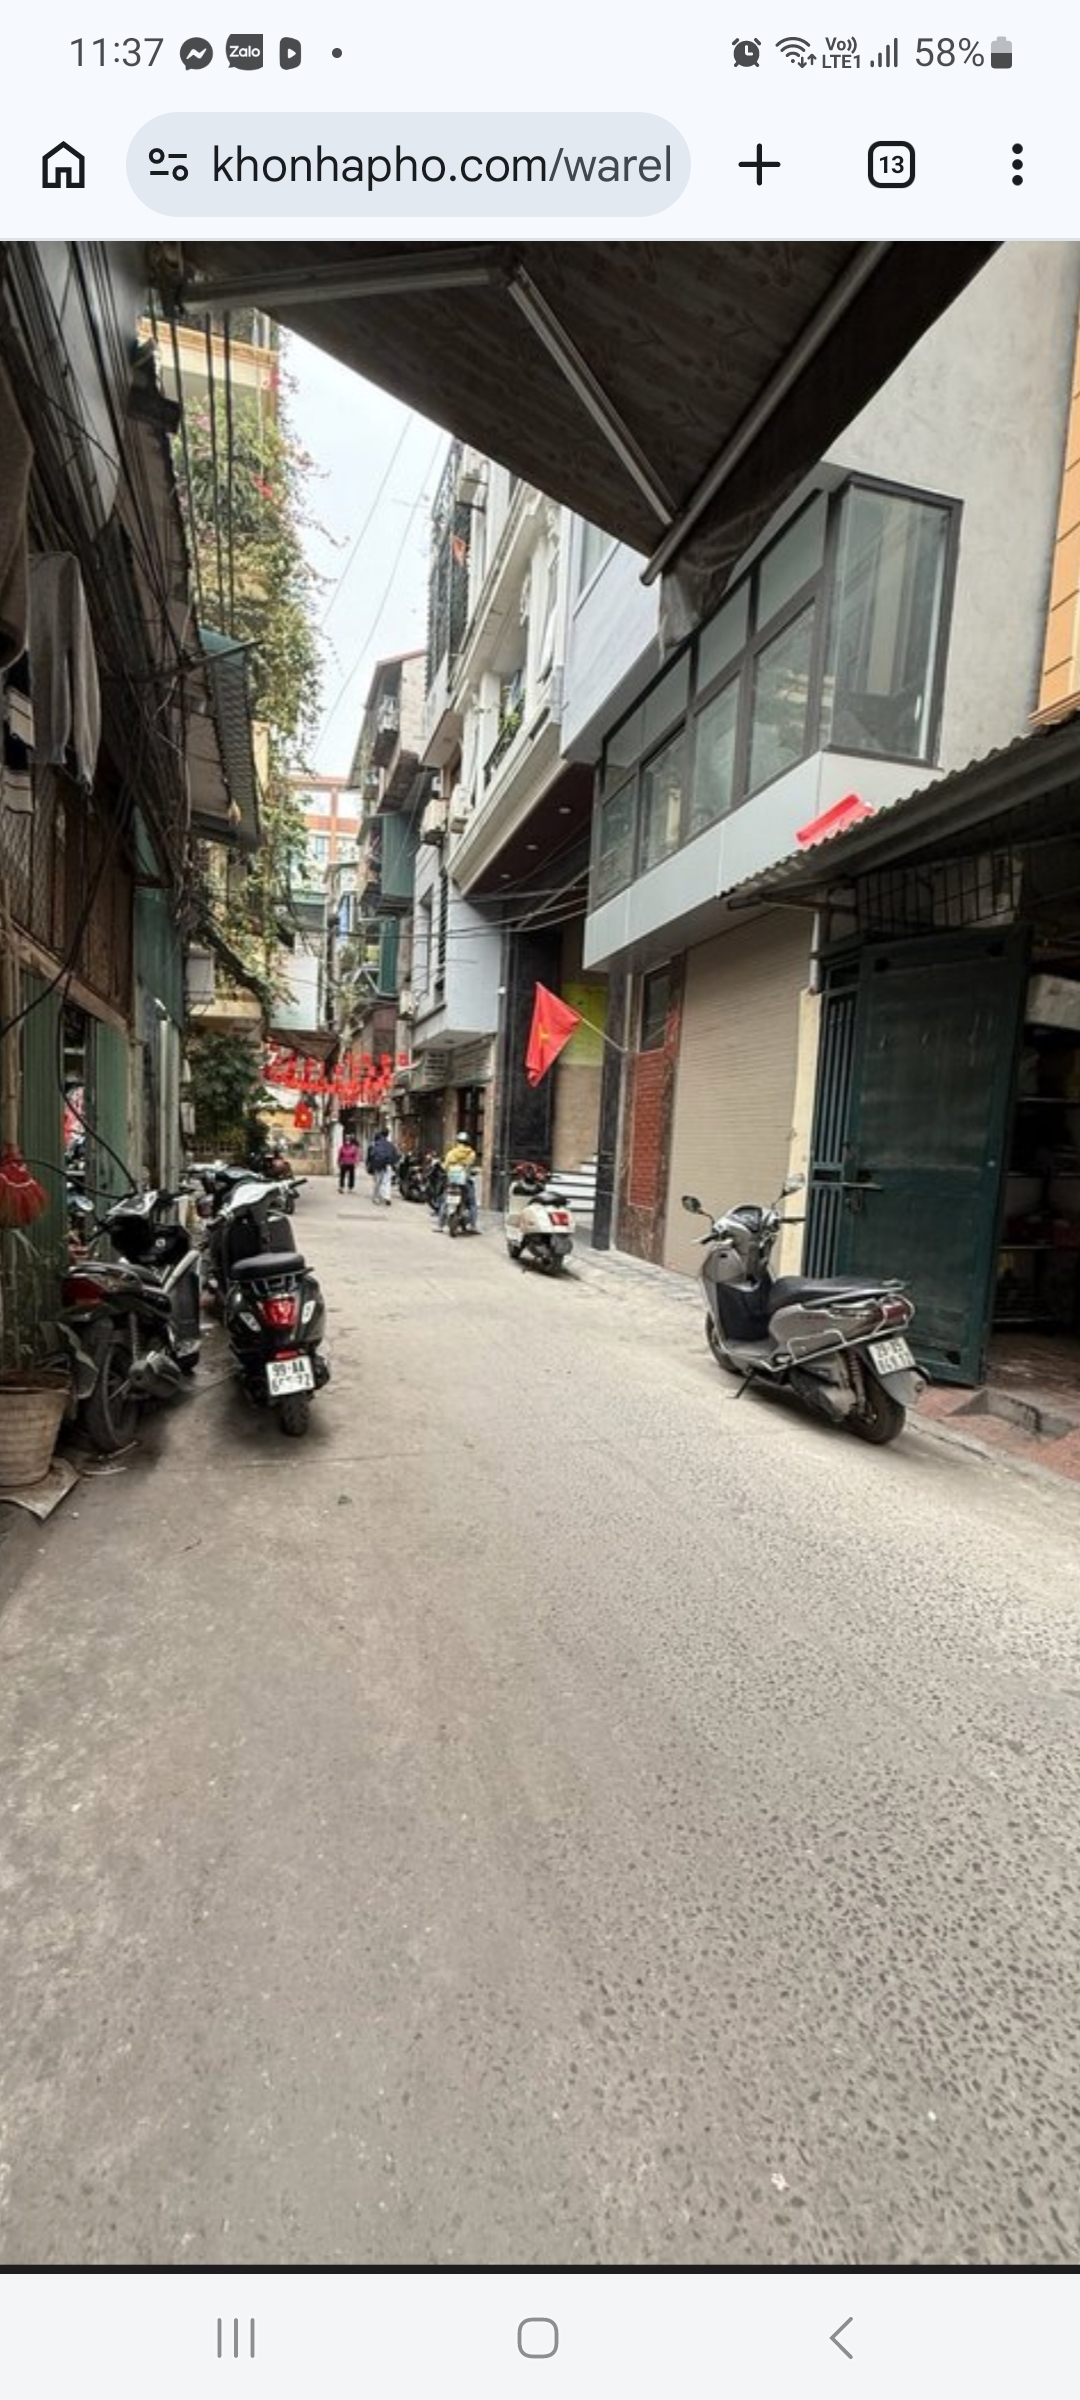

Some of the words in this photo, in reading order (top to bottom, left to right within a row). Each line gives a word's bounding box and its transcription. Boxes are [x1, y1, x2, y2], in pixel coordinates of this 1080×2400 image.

[71, 38, 163, 66] 11:37
[229, 45, 261, 58] Zalo
[916, 38, 985, 67] 58%
[822, 55, 860, 69] LTE1
[880, 154, 905, 174] 13
